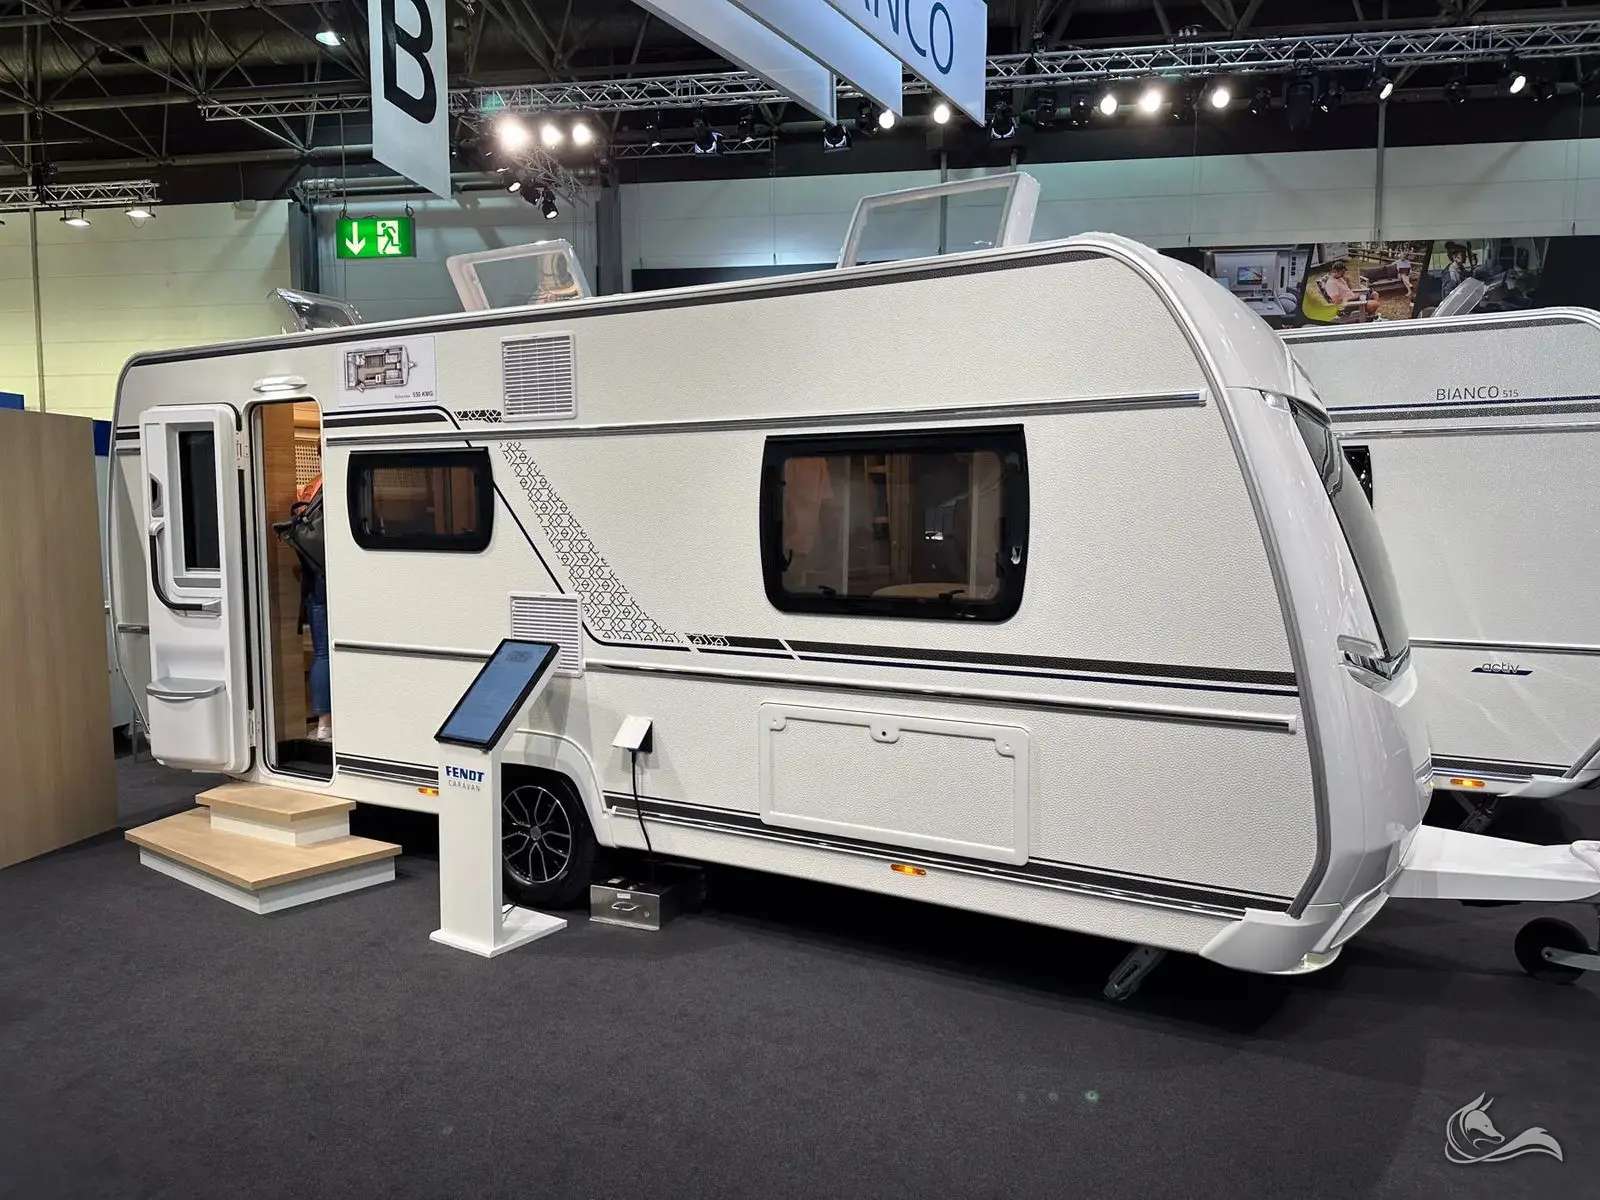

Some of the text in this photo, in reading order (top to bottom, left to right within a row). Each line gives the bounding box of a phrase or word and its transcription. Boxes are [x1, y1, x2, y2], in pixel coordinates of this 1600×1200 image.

[864, 0, 954, 75] CO
[381, 0, 437, 124] B
[1436, 385, 1519, 401] BIANCO 515
[1482, 661, 1520, 674] activ
[445, 765, 485, 782] FENDT
[448, 779, 481, 792] CARAVAN
